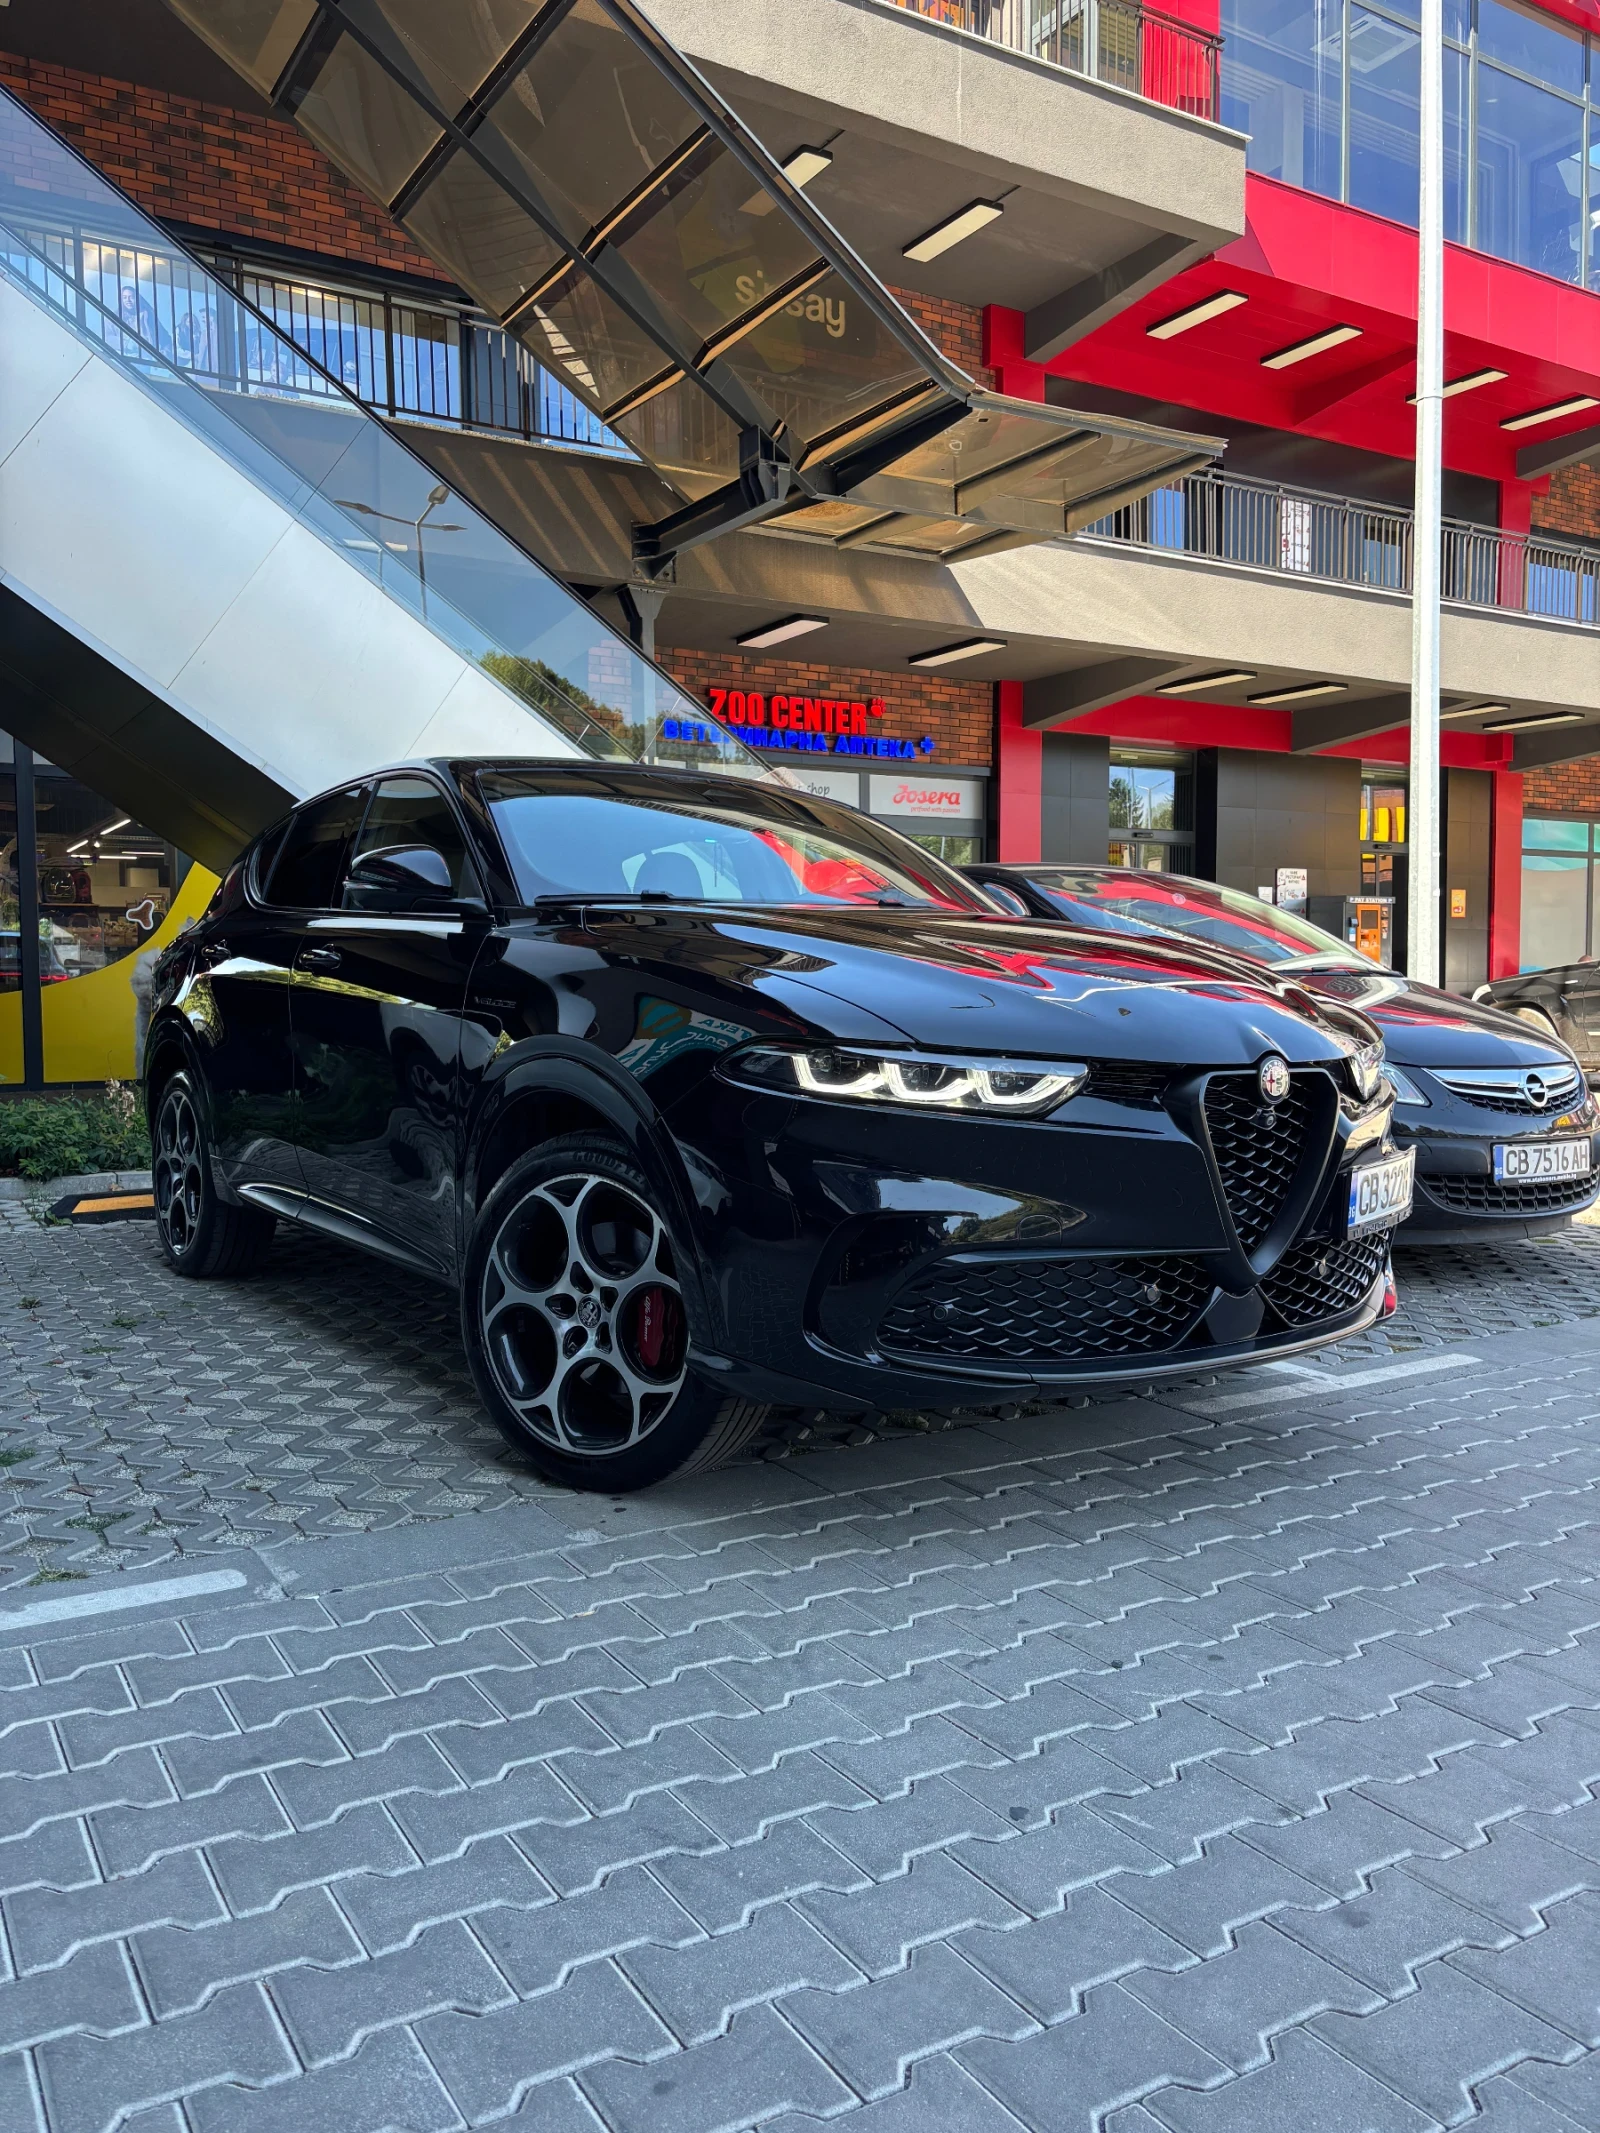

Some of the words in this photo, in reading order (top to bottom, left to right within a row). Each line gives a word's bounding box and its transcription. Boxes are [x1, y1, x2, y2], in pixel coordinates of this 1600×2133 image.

[709, 688, 765, 725] ZOO
[771, 695, 867, 735] CENTER
[834, 735, 917, 759] АПТЕКА
[892, 785, 961, 806] Josera
[1506, 1149, 1530, 1175] CB
[1533, 1146, 1570, 1174] 7516
[1572, 1144, 1588, 1170] AH
[1359, 1172, 1379, 1216] CB
